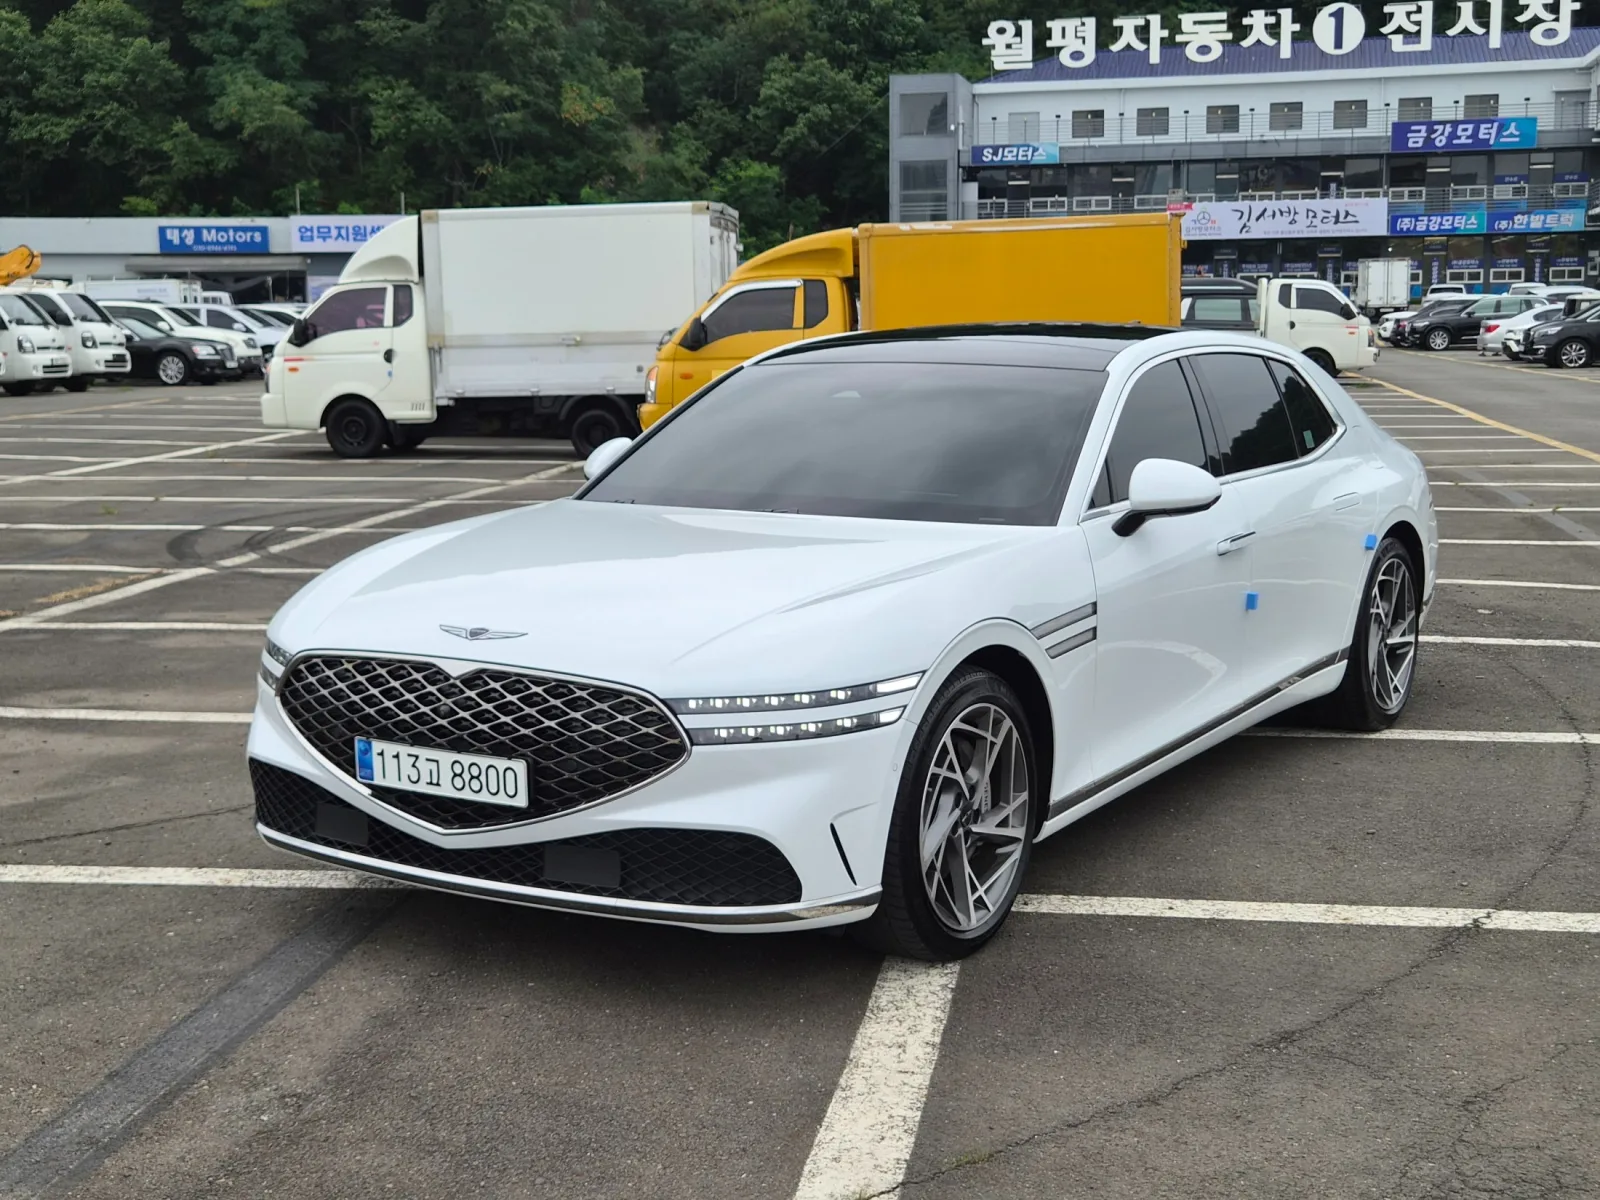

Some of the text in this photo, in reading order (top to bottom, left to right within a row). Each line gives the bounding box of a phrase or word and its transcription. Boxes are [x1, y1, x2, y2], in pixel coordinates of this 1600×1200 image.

[982, 8, 1300, 70] 월평자동차
[1379, 0, 1581, 52] 전시장
[1407, 121, 1521, 147] 금강모터스
[982, 146, 1047, 162] SJ모터스
[1231, 205, 1360, 234] 김서방 모터스
[1396, 215, 1478, 231] (주)금강모터스
[203, 227, 263, 243] Motors
[376, 748, 518, 799] 113고 8800
